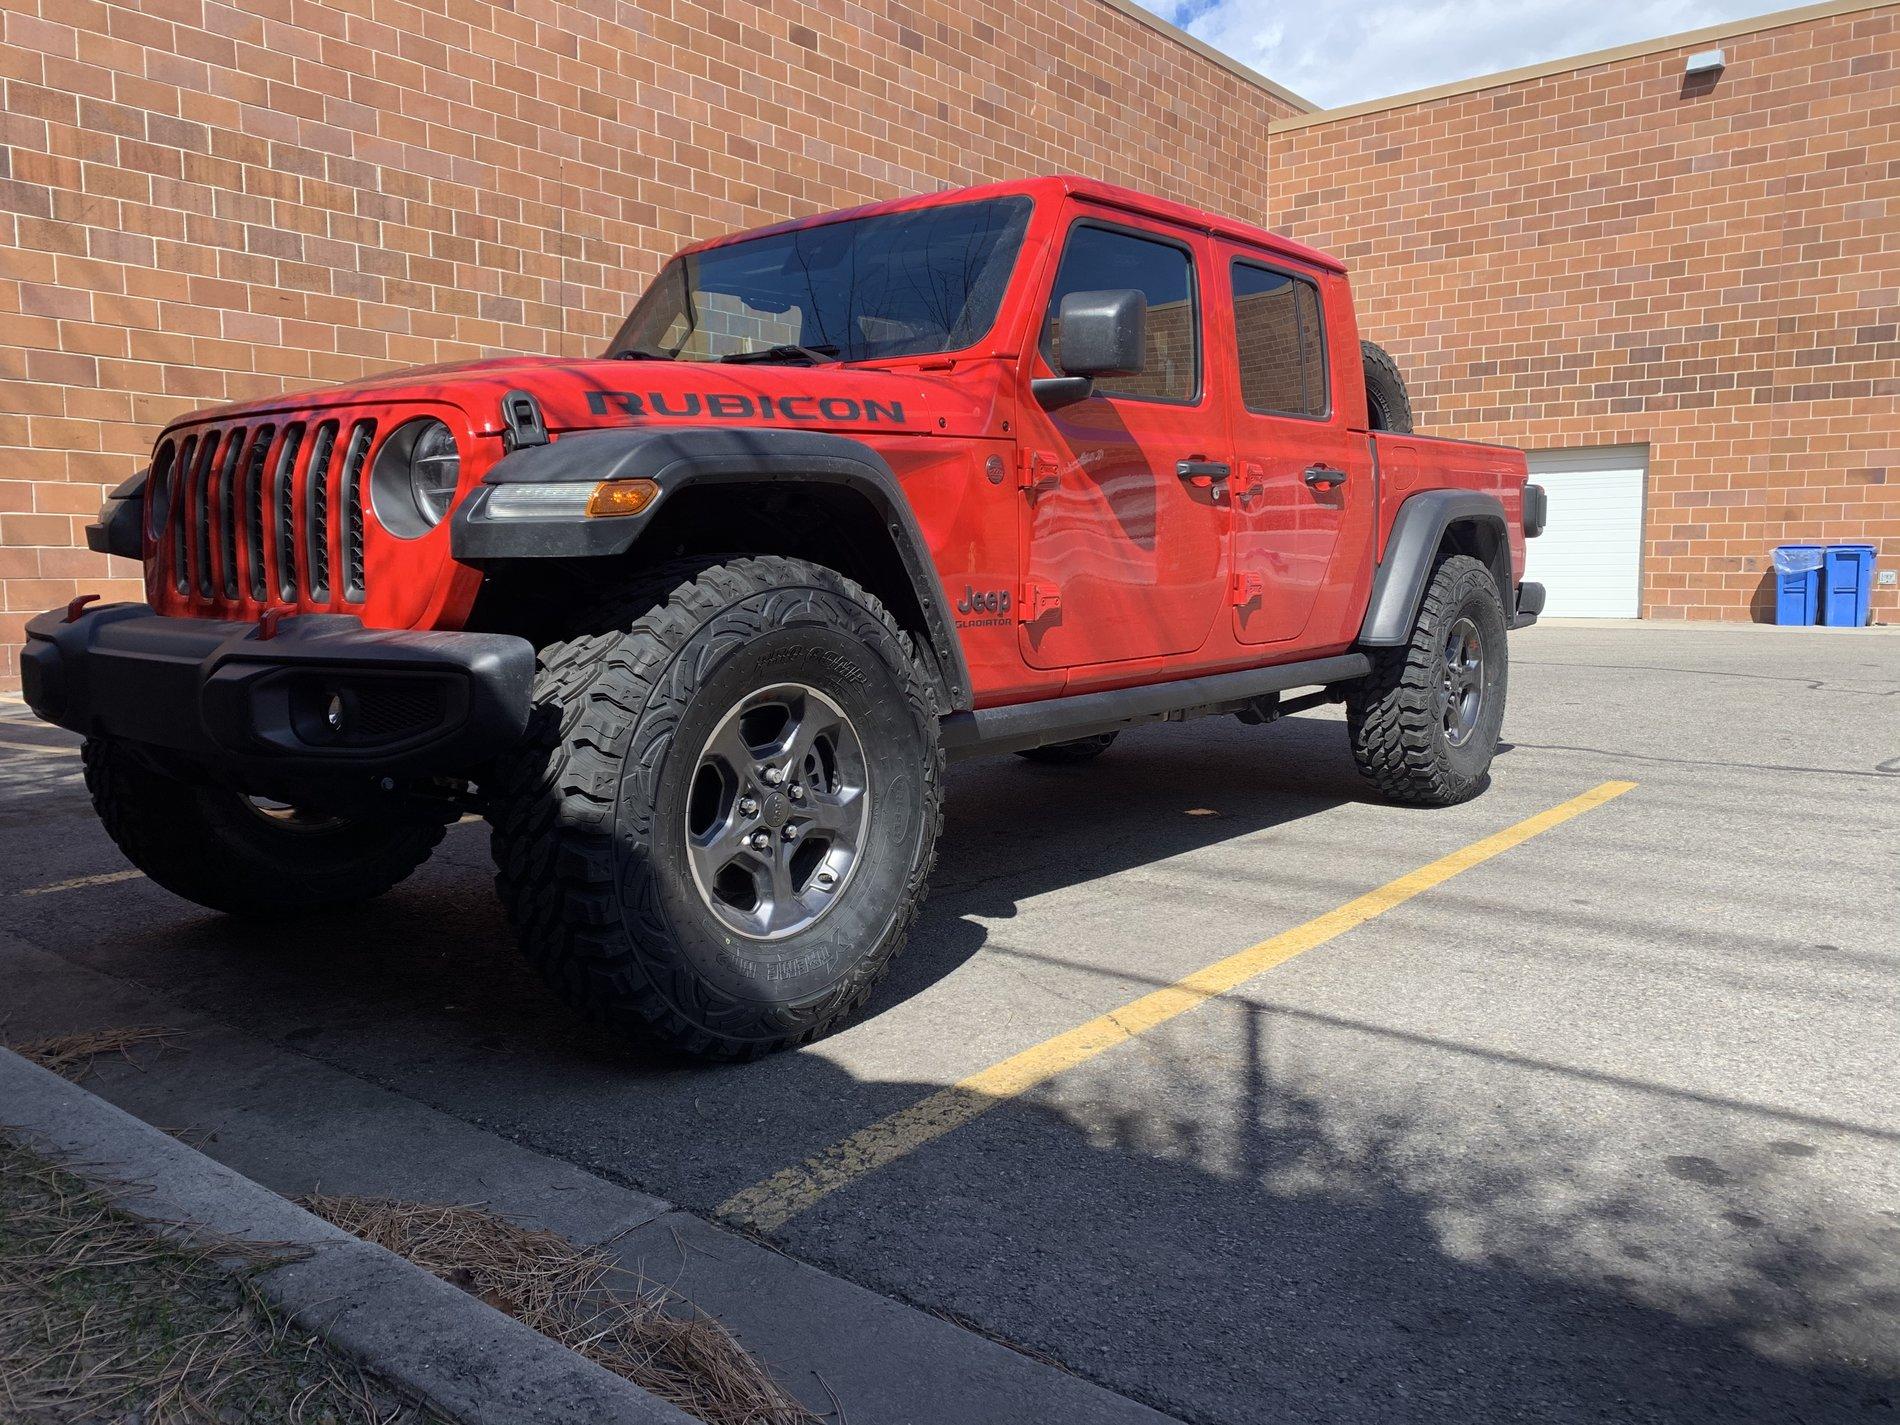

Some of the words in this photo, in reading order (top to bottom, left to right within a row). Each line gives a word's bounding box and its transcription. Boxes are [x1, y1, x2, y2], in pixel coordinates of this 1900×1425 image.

[584, 391, 905, 423] RUBICON
[957, 585, 1011, 617] Jeep
[956, 619, 1012, 629] GLADIATOR
